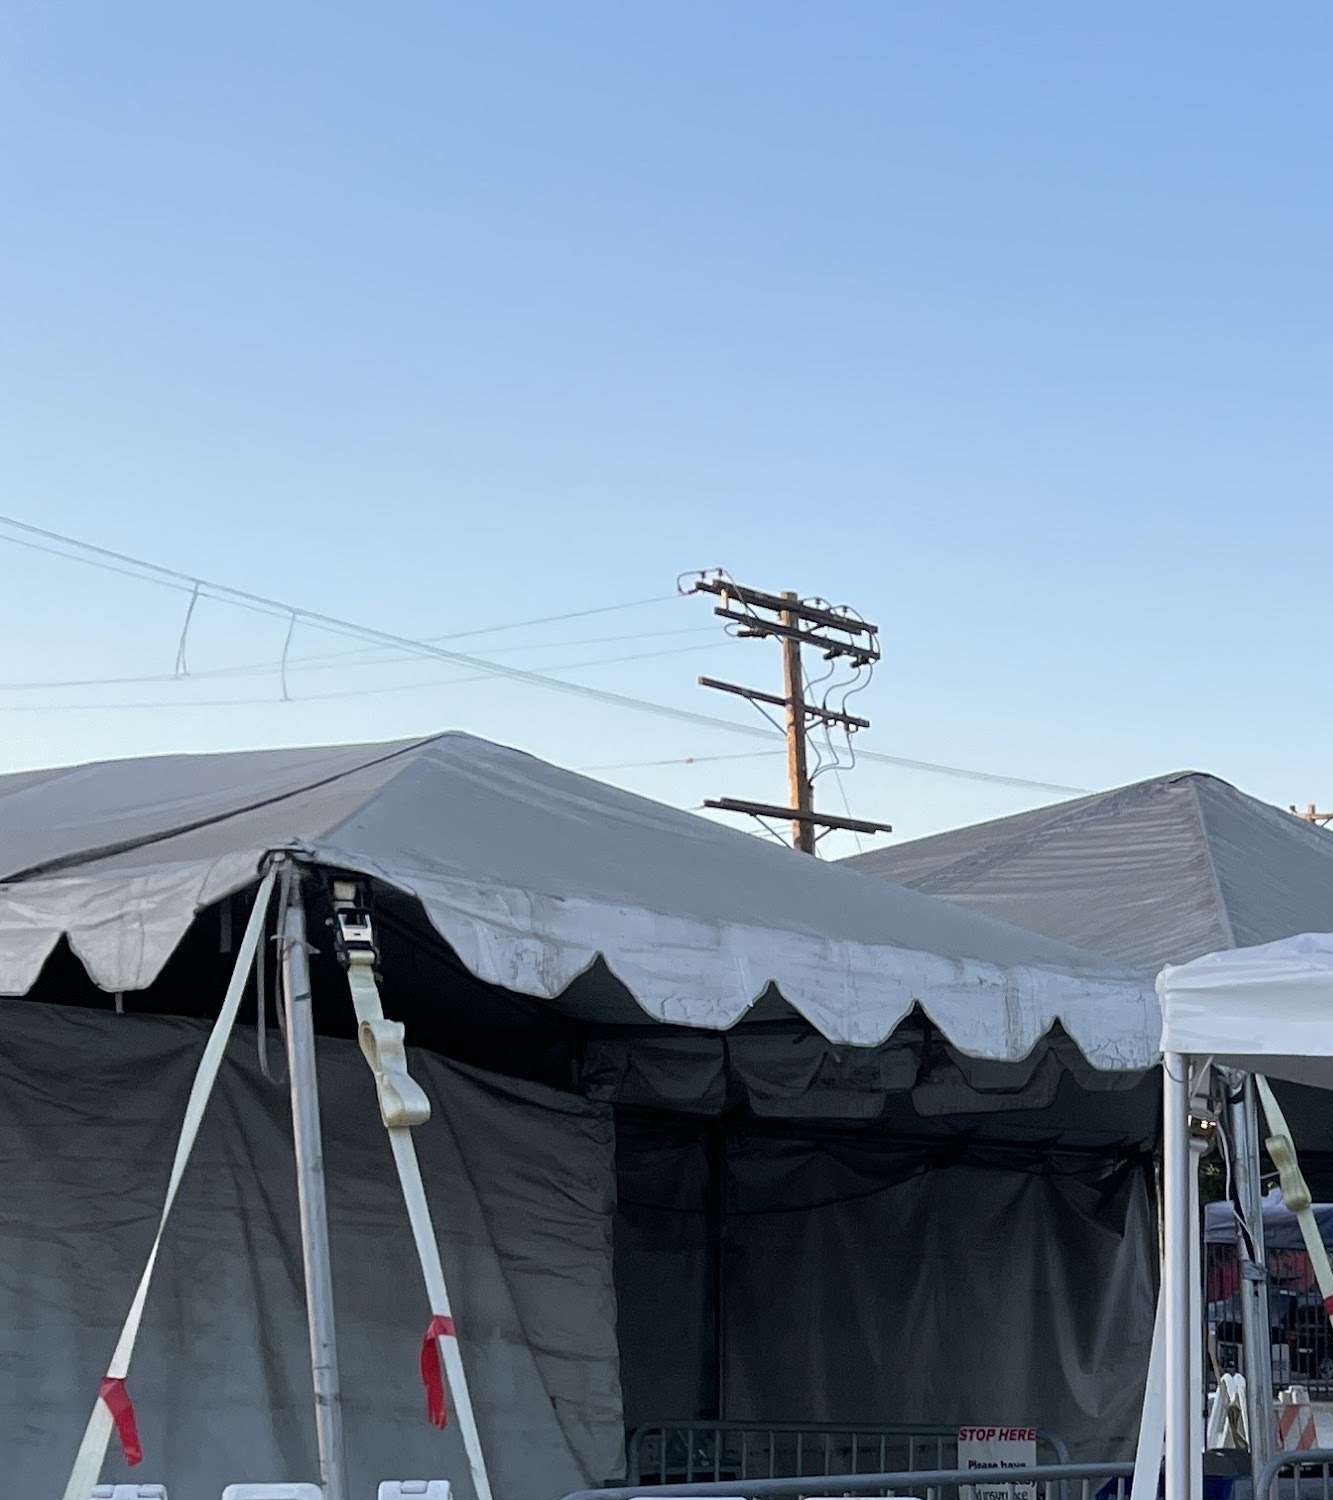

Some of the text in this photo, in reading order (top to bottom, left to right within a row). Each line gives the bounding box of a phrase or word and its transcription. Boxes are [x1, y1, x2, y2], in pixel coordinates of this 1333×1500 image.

[959, 1429, 1037, 1441] STOP HERE
[968, 1460, 1026, 1470] Please have
